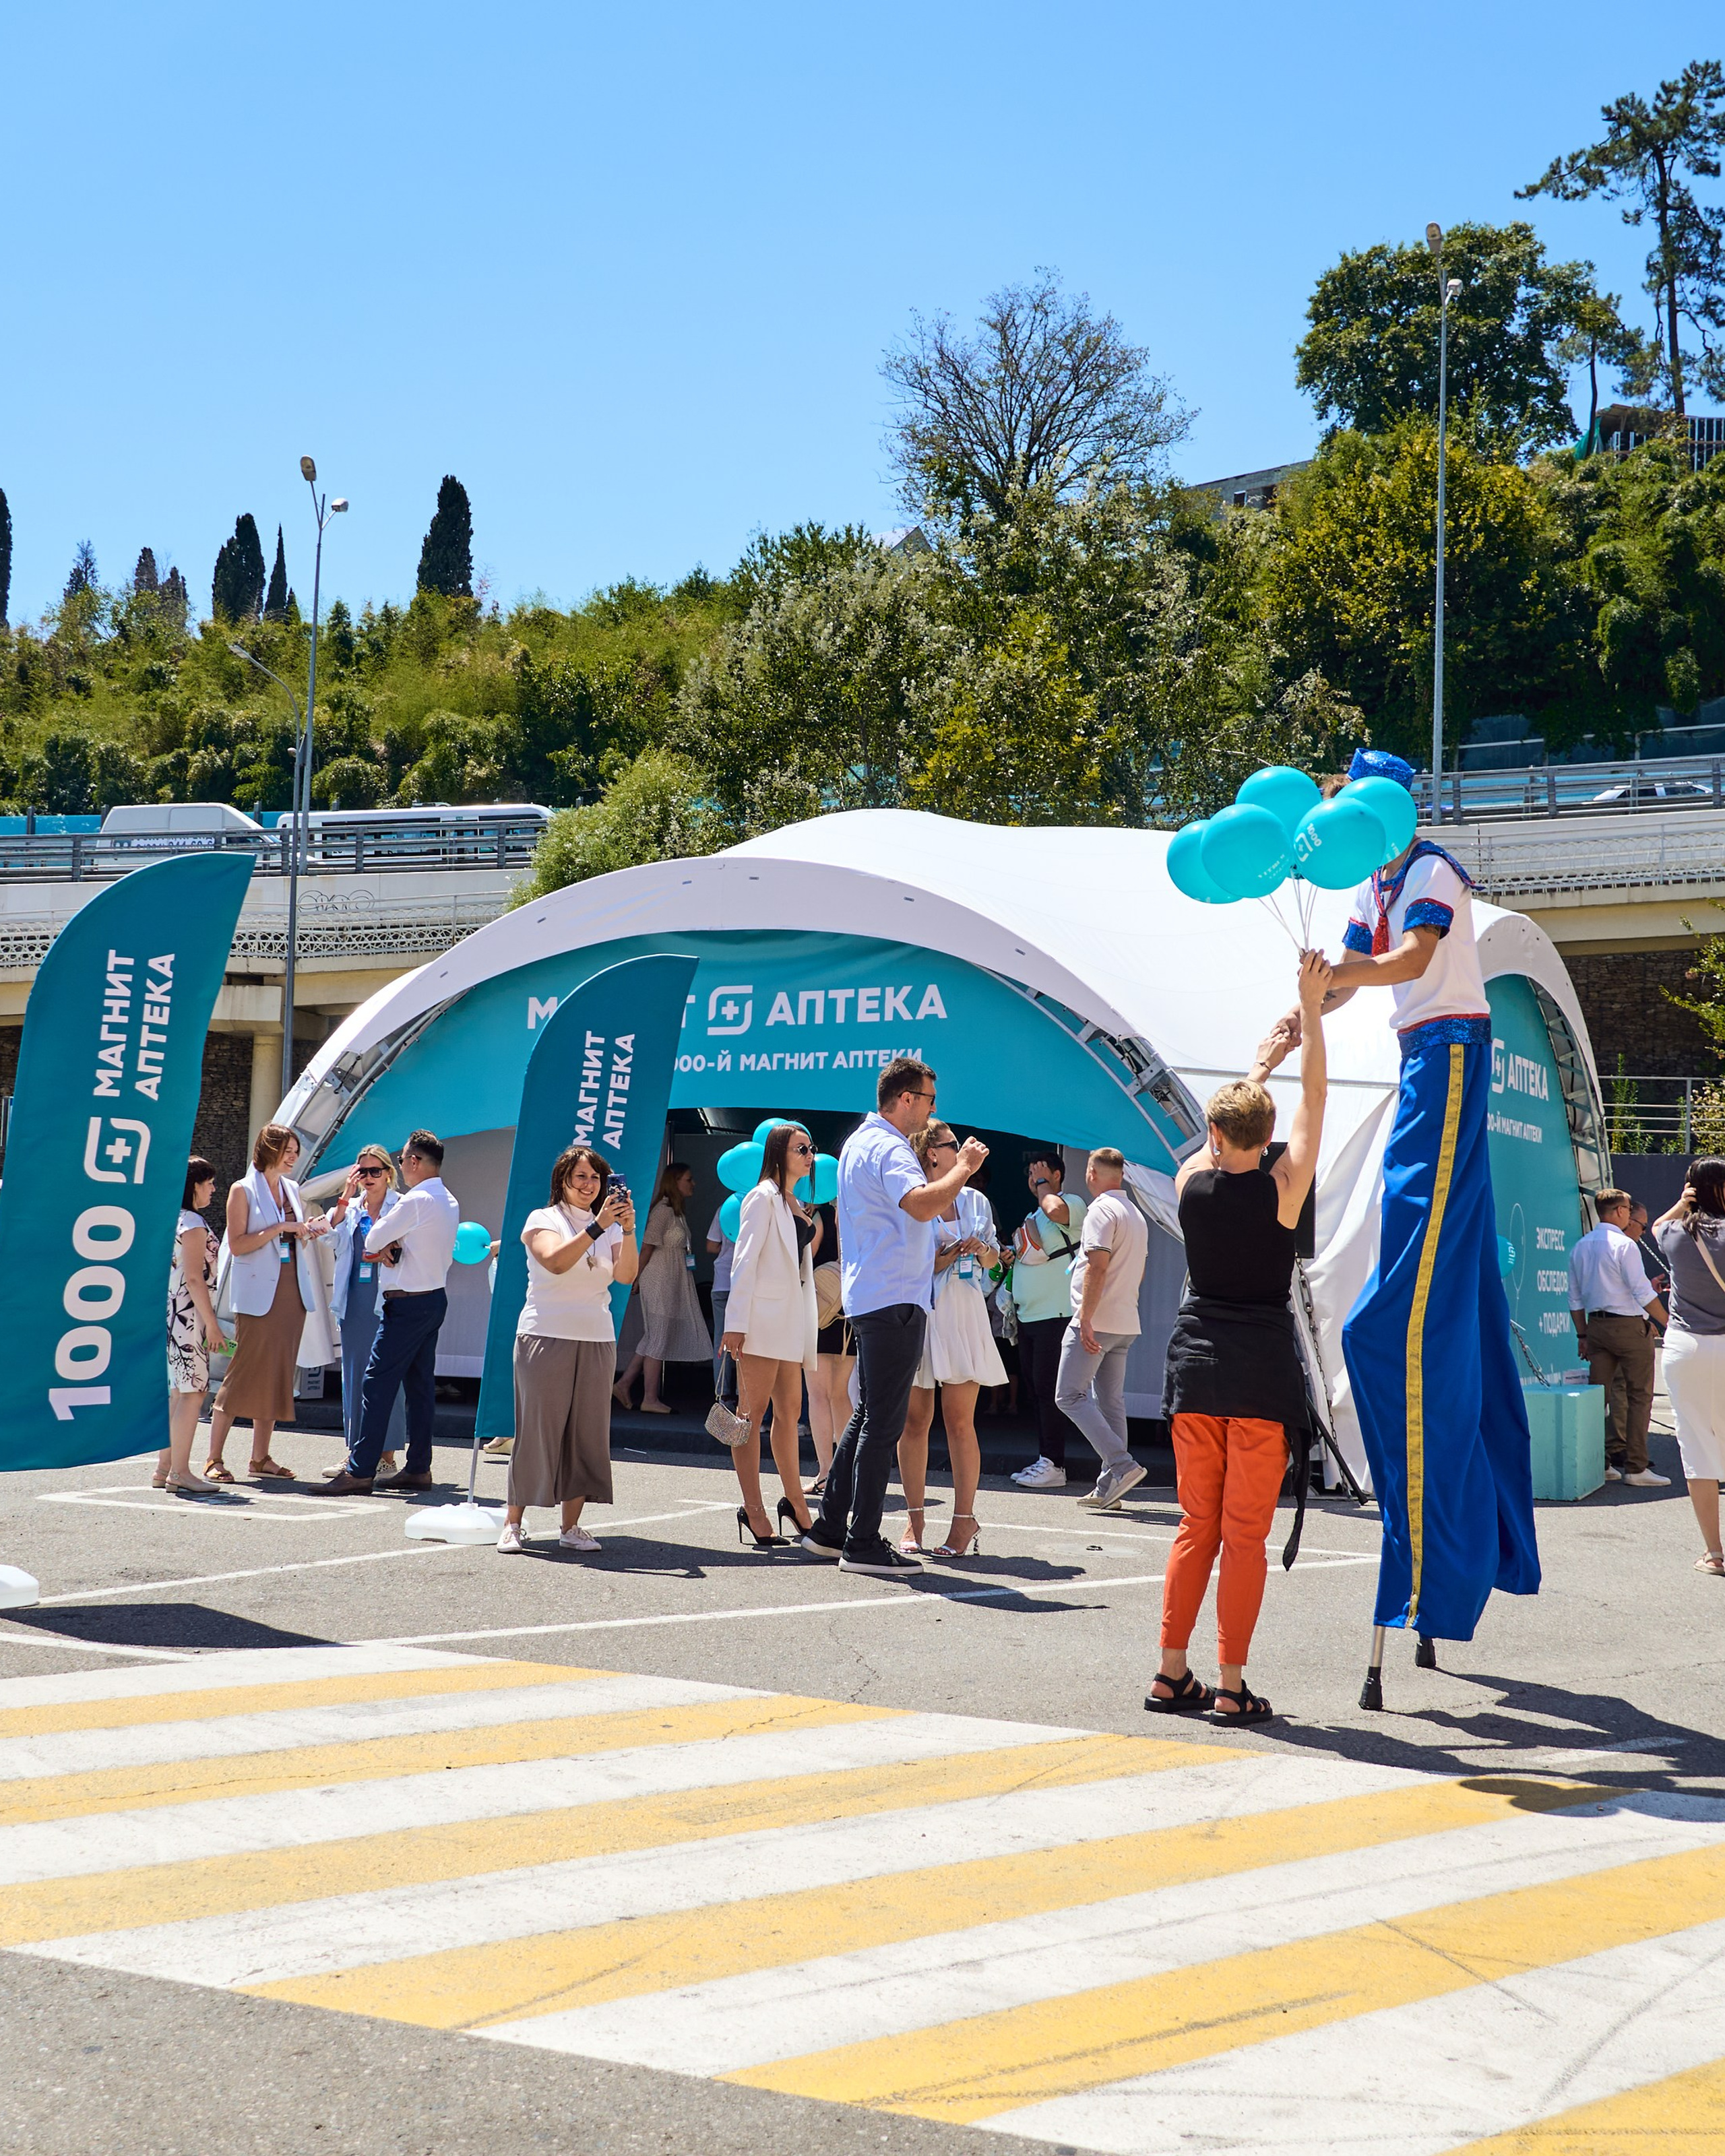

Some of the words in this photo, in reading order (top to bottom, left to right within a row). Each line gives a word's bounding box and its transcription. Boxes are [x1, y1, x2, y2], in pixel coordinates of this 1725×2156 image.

[1307, 823, 1322, 846] 1000
[93, 949, 134, 1097] МАГНИТ
[135, 953, 175, 1101] АПТЕКА
[765, 984, 947, 1026] АПТЕКА
[740, 1052, 829, 1071] МАГНИТ
[1507, 1053, 1549, 1102] АПТЕКА
[572, 1030, 605, 1146] МАГНИТ
[602, 1034, 635, 1149] АПТЕКА
[1501, 1116, 1523, 1139] МАГНИТ
[1536, 1227, 1565, 1252] ЭКСПРЕСС
[49, 1205, 135, 1420] 1000
